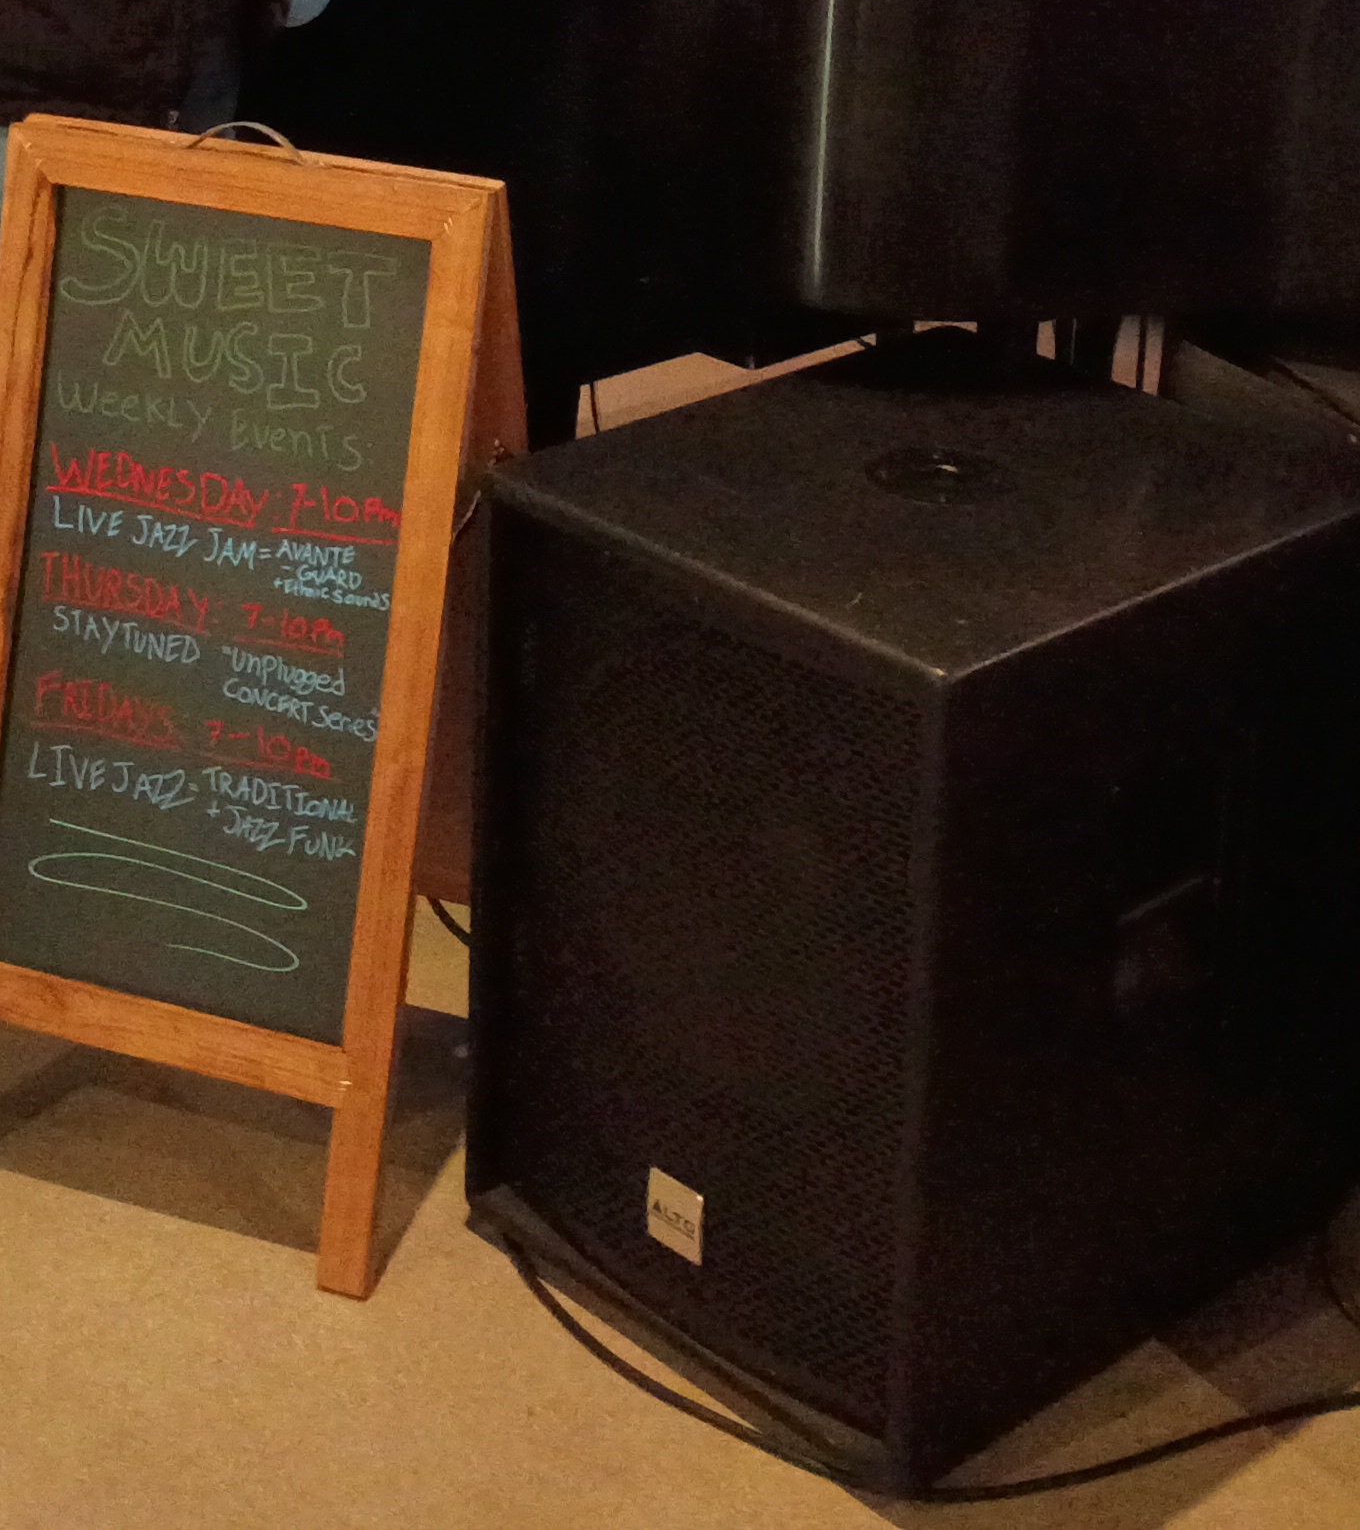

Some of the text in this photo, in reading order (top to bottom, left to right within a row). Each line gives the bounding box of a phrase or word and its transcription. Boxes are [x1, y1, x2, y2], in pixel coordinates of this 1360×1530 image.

[60, 206, 398, 328] SWEET
[102, 308, 367, 410] MUSIC
[53, 495, 124, 537] LIVE
[131, 515, 199, 558] JAZZ
[275, 538, 356, 567] AVANTE
[223, 677, 315, 723] CONCERT
[27, 743, 105, 790] LIVE
[202, 766, 358, 823] TRADITIONAL
[223, 805, 286, 852] JAZZ
[288, 826, 356, 861] FUNK
